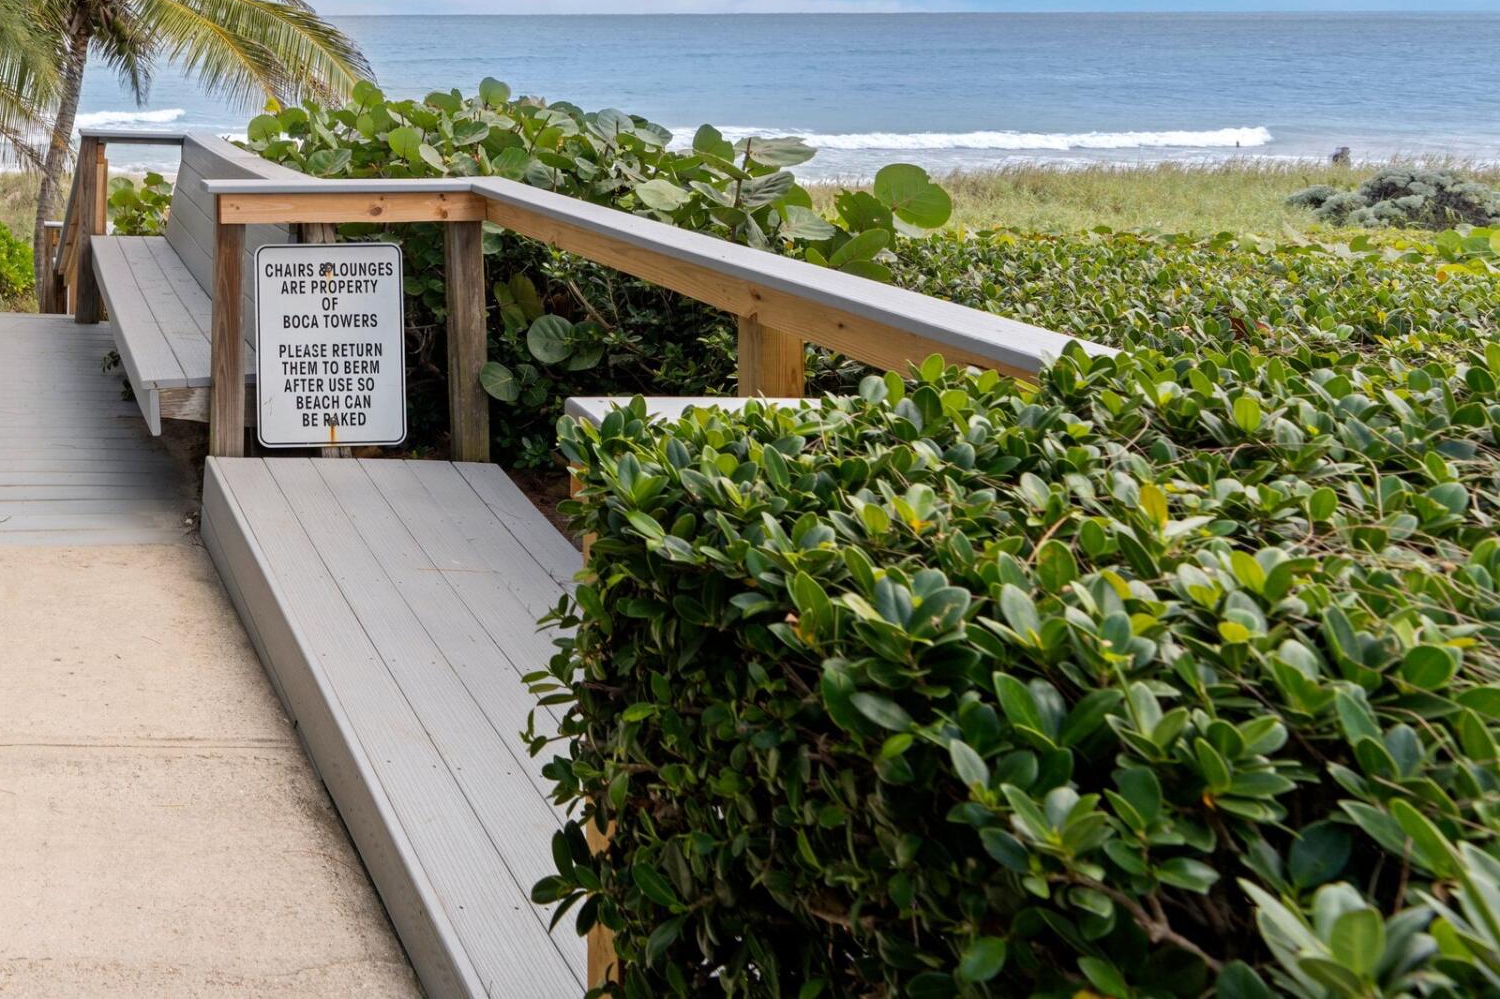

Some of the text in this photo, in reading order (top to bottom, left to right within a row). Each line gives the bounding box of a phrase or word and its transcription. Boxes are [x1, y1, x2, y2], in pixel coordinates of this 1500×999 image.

[265, 264, 313, 277] CHAIRS
[333, 262, 393, 277] LOUNGES
[281, 280, 378, 294] ARE PROPERTY
[322, 297, 338, 310] OF
[284, 314, 377, 328] BOCA TOWERS
[280, 343, 382, 358] PLEASE RETURN
[282, 361, 379, 375] THEM TO BERM
[284, 378, 374, 392] AFTER USE SO
[297, 396, 371, 409] BEACH CAN
[303, 413, 318, 426] BE
